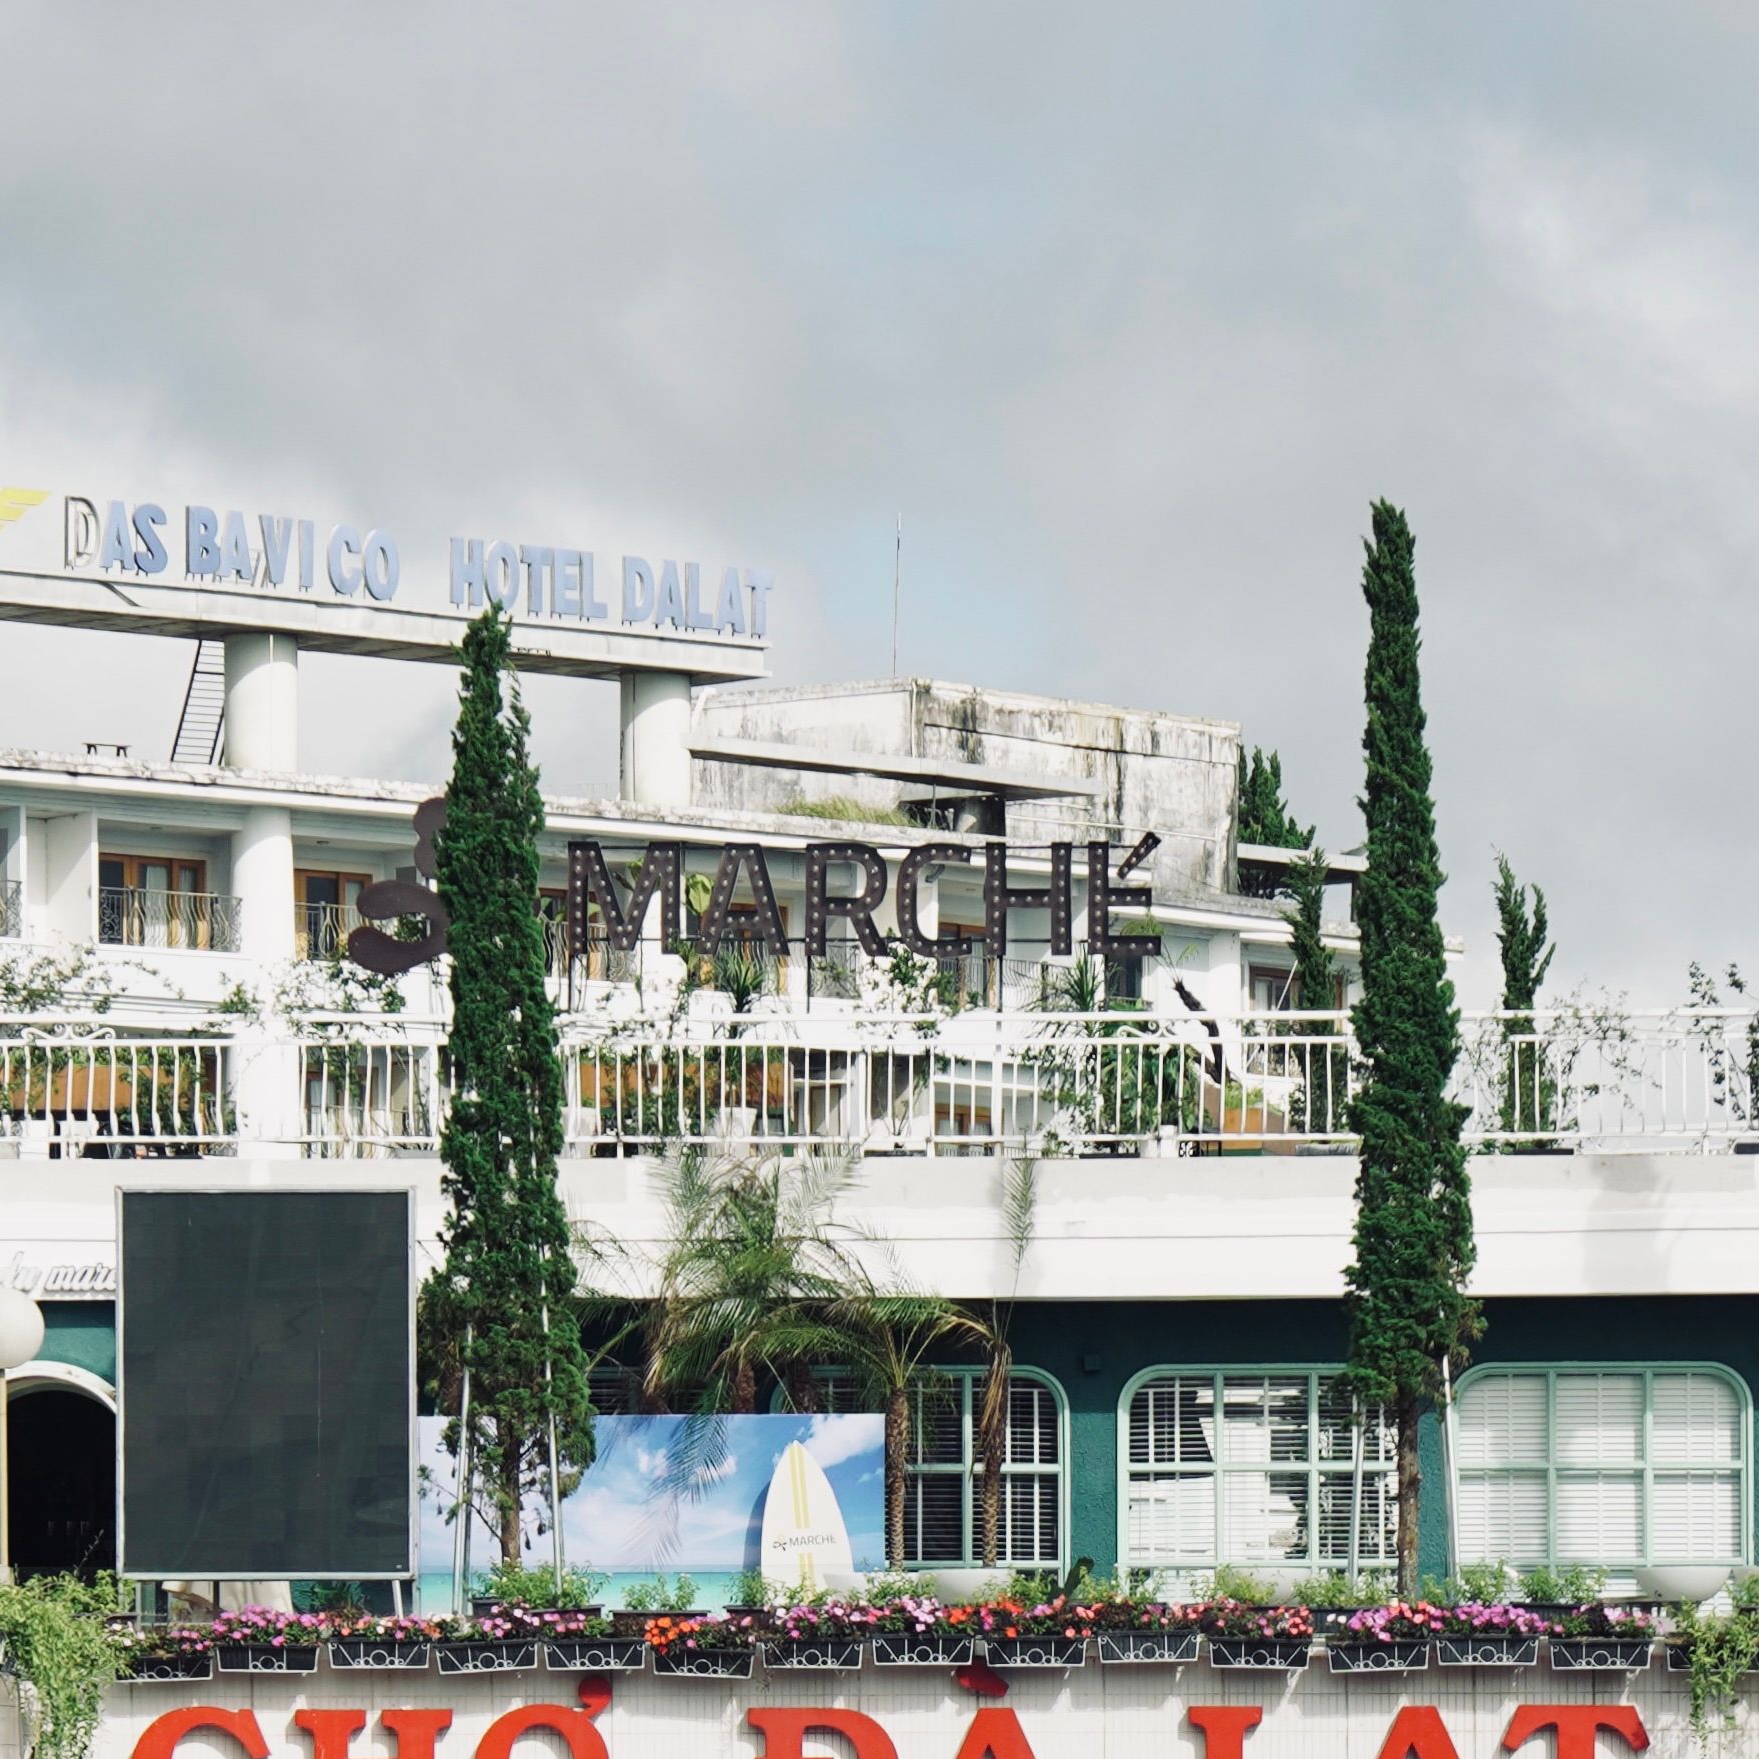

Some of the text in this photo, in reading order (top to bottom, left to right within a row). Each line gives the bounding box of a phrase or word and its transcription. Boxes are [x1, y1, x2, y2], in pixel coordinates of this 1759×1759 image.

[63, 495, 169, 573] DAS
[449, 537, 609, 618] HOTEL
[621, 555, 775, 636] DALAT
[569, 831, 1163, 956] MARCHÉ
